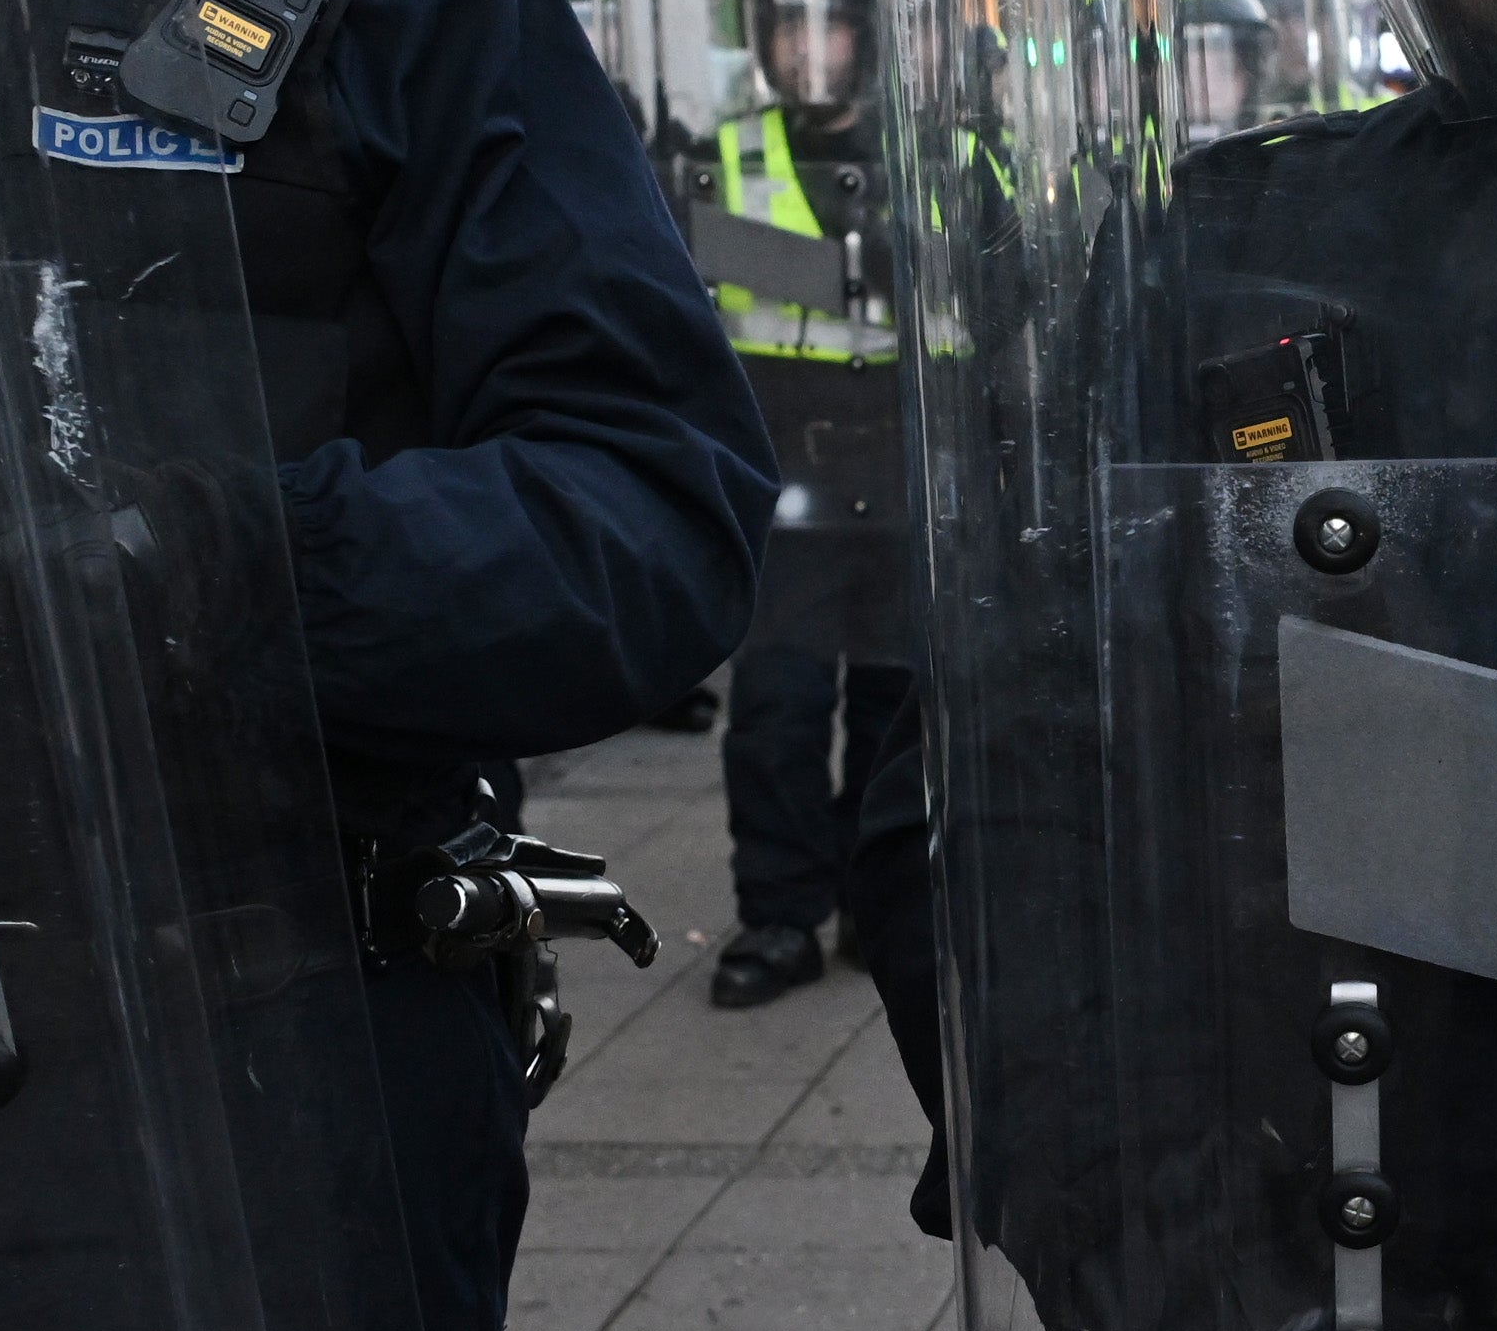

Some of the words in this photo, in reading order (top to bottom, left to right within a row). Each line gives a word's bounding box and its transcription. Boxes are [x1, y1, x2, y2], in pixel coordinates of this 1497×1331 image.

[204, 25, 226, 40] AUDIO
[231, 37, 252, 53] VIDEO
[218, 13, 265, 44] WARNING
[1247, 423, 1288, 441] WARNING
